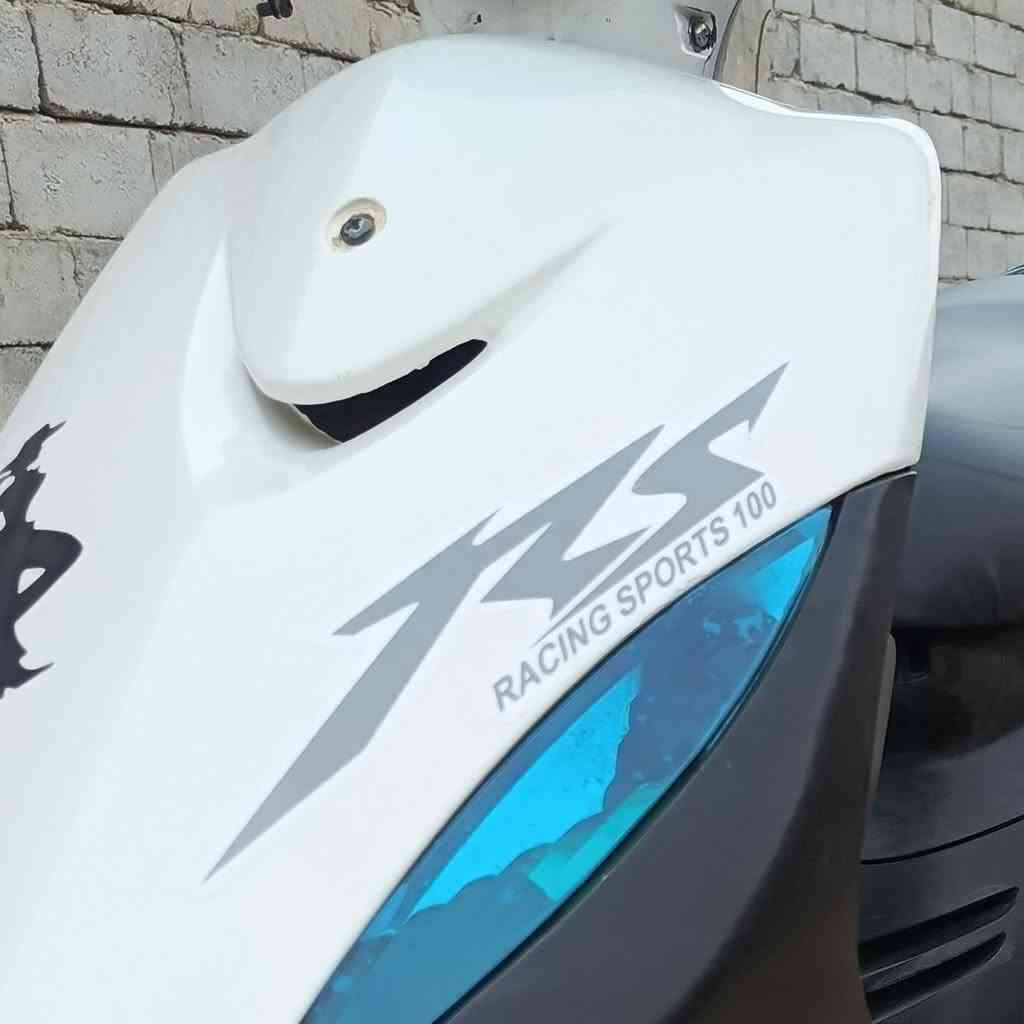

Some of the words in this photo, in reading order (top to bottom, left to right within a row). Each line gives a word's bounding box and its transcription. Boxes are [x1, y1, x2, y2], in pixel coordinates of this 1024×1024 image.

[492, 603, 613, 712] RACING
[615, 515, 731, 617] SPORTS
[732, 480, 778, 529] 100
